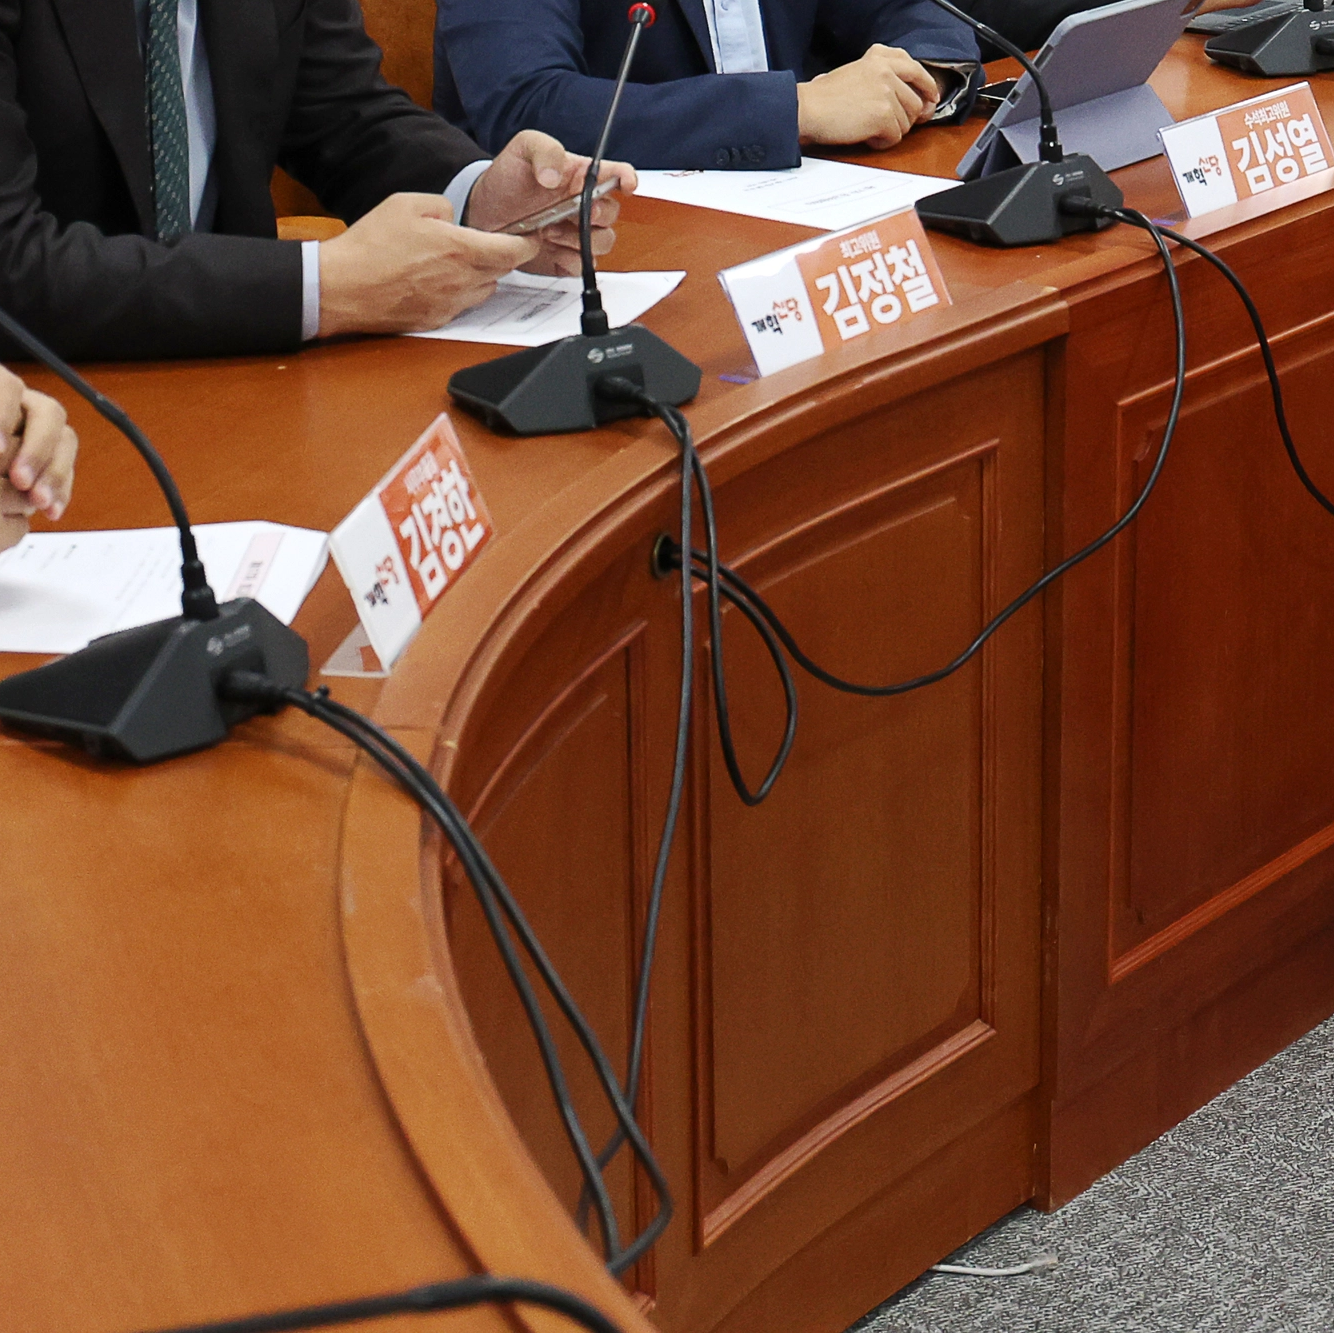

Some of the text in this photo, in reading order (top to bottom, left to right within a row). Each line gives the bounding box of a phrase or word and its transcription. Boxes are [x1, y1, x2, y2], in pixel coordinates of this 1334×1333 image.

[1231, 113, 1329, 195] 김성열
[1244, 100, 1292, 129] 수석최고위원
[839, 229, 883, 259] 최고위원
[814, 238, 940, 341] 김정철
[398, 459, 486, 601] 김경한
